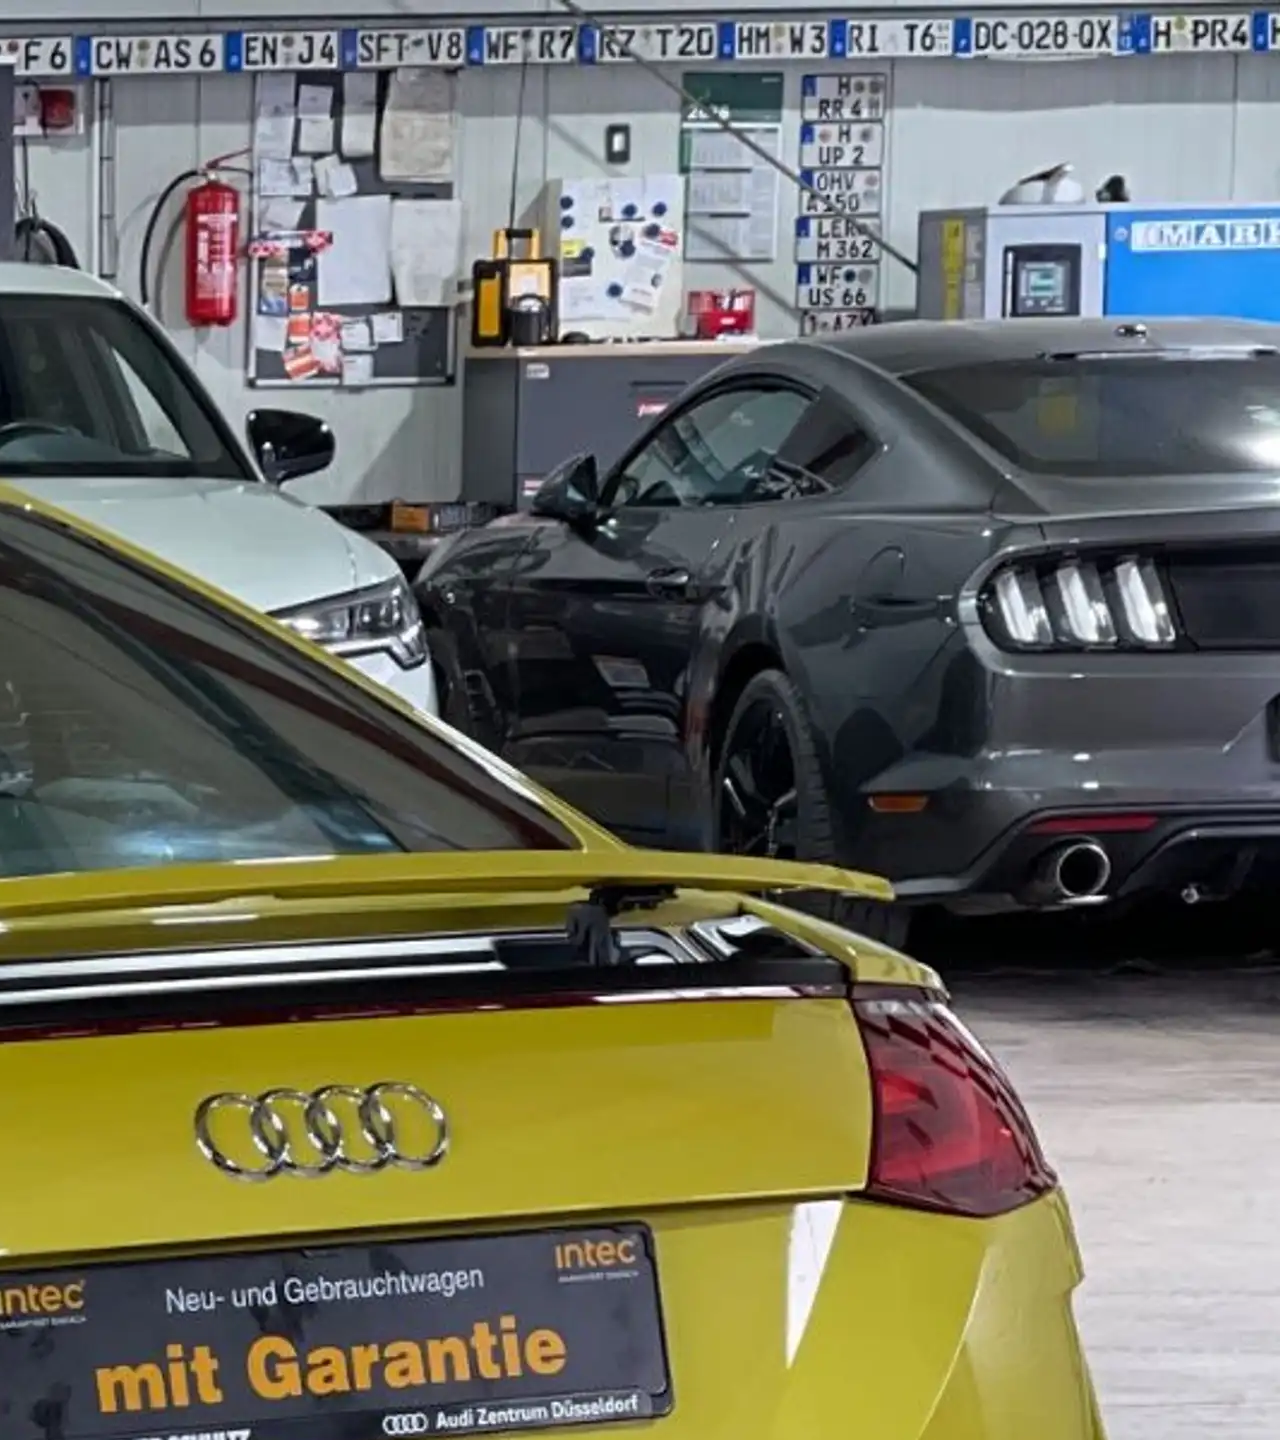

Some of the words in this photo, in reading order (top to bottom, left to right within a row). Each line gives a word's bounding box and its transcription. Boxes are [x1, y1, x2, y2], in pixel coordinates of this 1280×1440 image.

[357, 32, 410, 62] SFT
[486, 30, 520, 61] WF
[737, 25, 772, 56] HM
[847, 23, 880, 53] RI
[1152, 20, 1173, 48] H
[95, 39, 133, 70] CW
[244, 35, 279, 66] EN
[837, 76, 852, 96] H
[838, 123, 852, 143] H
[818, 146, 845, 165] UP
[835, 240, 874, 259] 362
[808, 288, 835, 307] US
[841, 287, 867, 307] 66
[554, 1234, 638, 1269] intec
[165, 1287, 226, 1315] Neu-
[230, 1279, 280, 1309] und
[283, 1266, 485, 1304] Gebrauchtwagen
[95, 1342, 224, 1414] mit
[246, 1314, 567, 1400] Garantie
[435, 1408, 474, 1431] Audi
[476, 1403, 549, 1428] Zentrum
[550, 1393, 640, 1421] Düsseldorf
